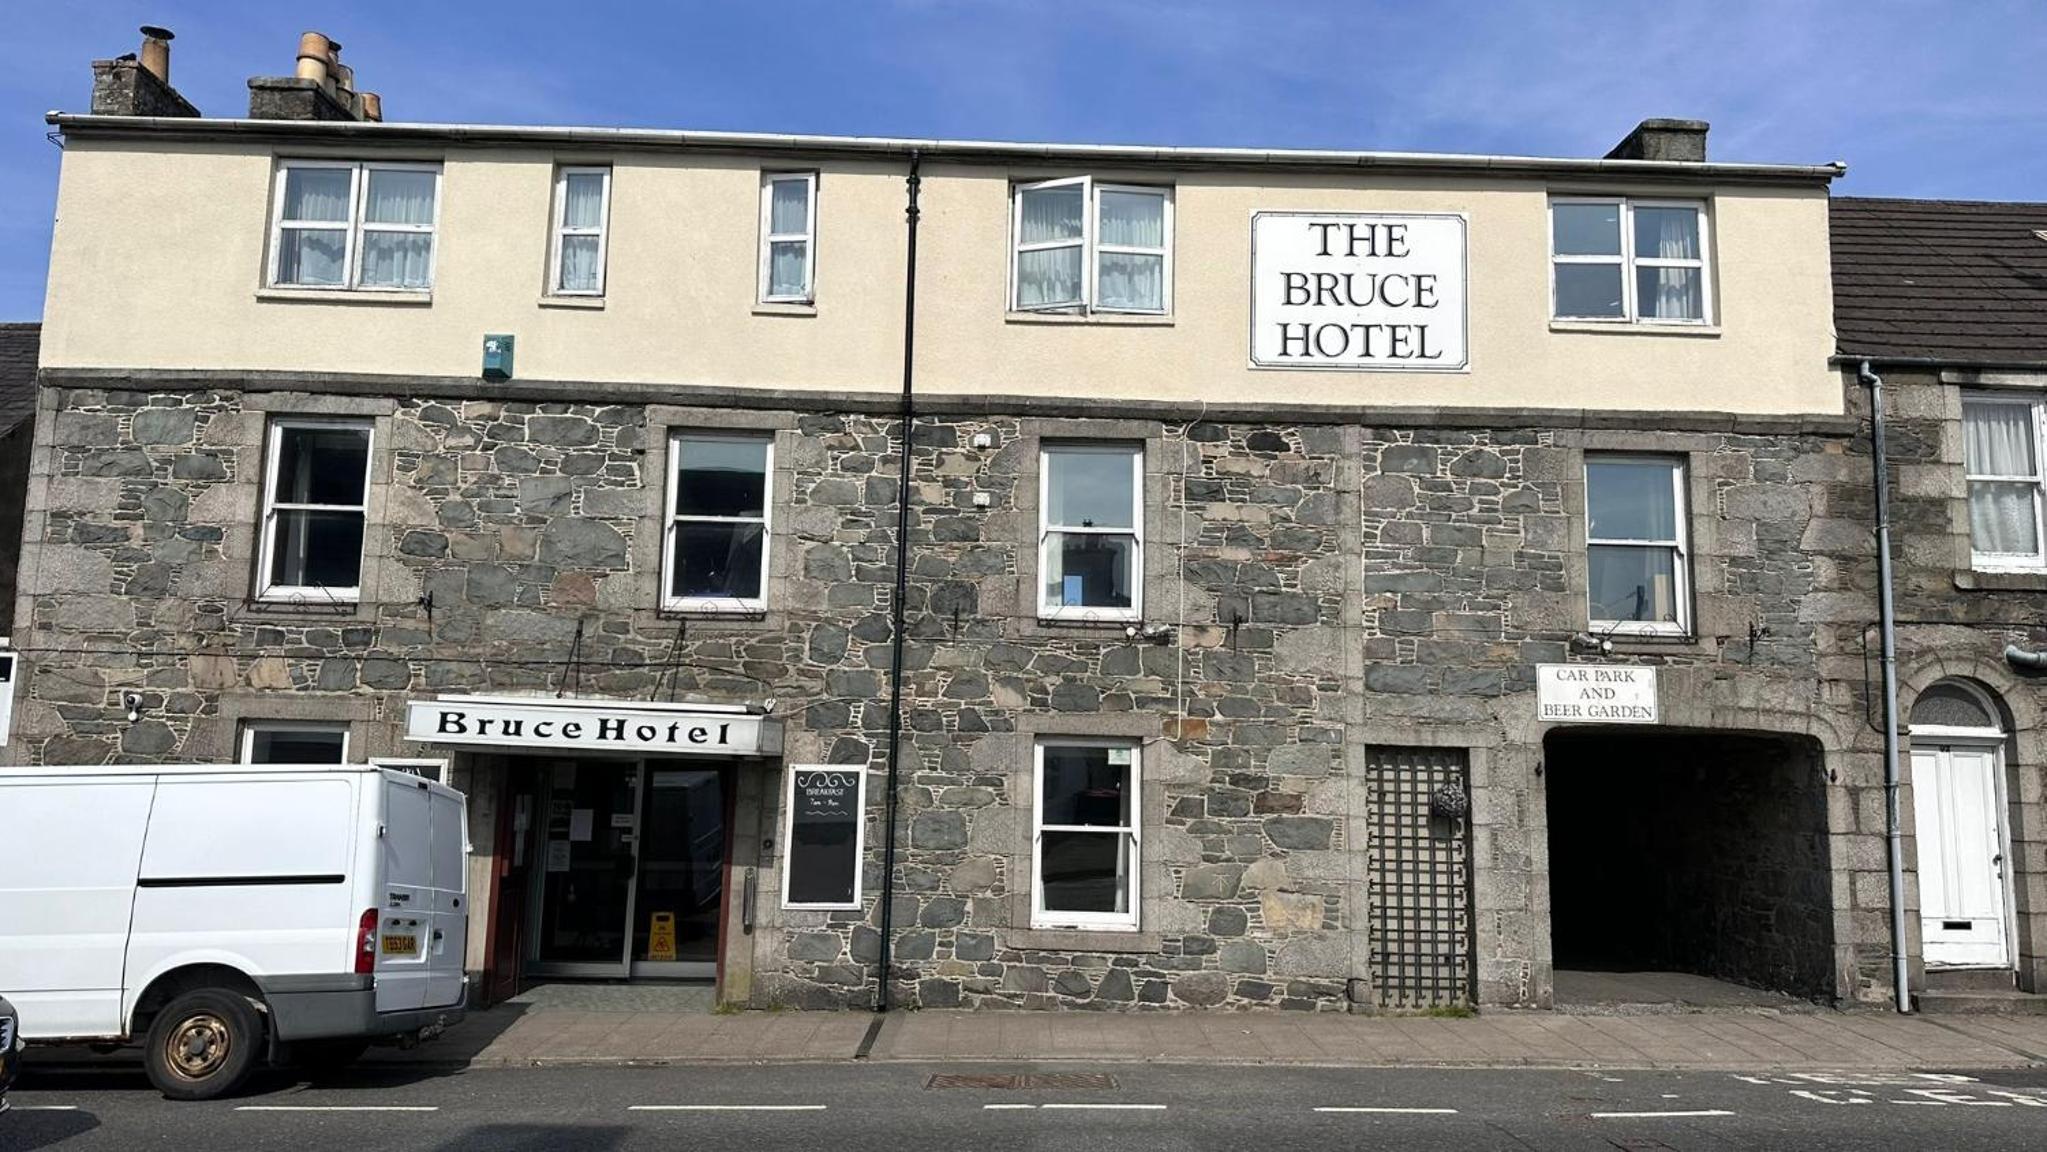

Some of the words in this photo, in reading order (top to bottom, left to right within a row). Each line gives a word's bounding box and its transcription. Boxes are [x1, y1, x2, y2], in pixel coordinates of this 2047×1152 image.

[1308, 222, 1411, 258] THE
[1279, 271, 1440, 309] BRUCE
[1276, 322, 1443, 360] HOTEL
[1556, 668, 1589, 681] CAR
[1595, 669, 1636, 683] PARK
[1579, 687, 1616, 700] AND
[1543, 703, 1582, 717] BEER
[1587, 705, 1653, 719] GARDEN
[436, 711, 582, 740] Bruce
[596, 717, 730, 745] Hotel
[805, 787, 844, 797] BREAKFAST
